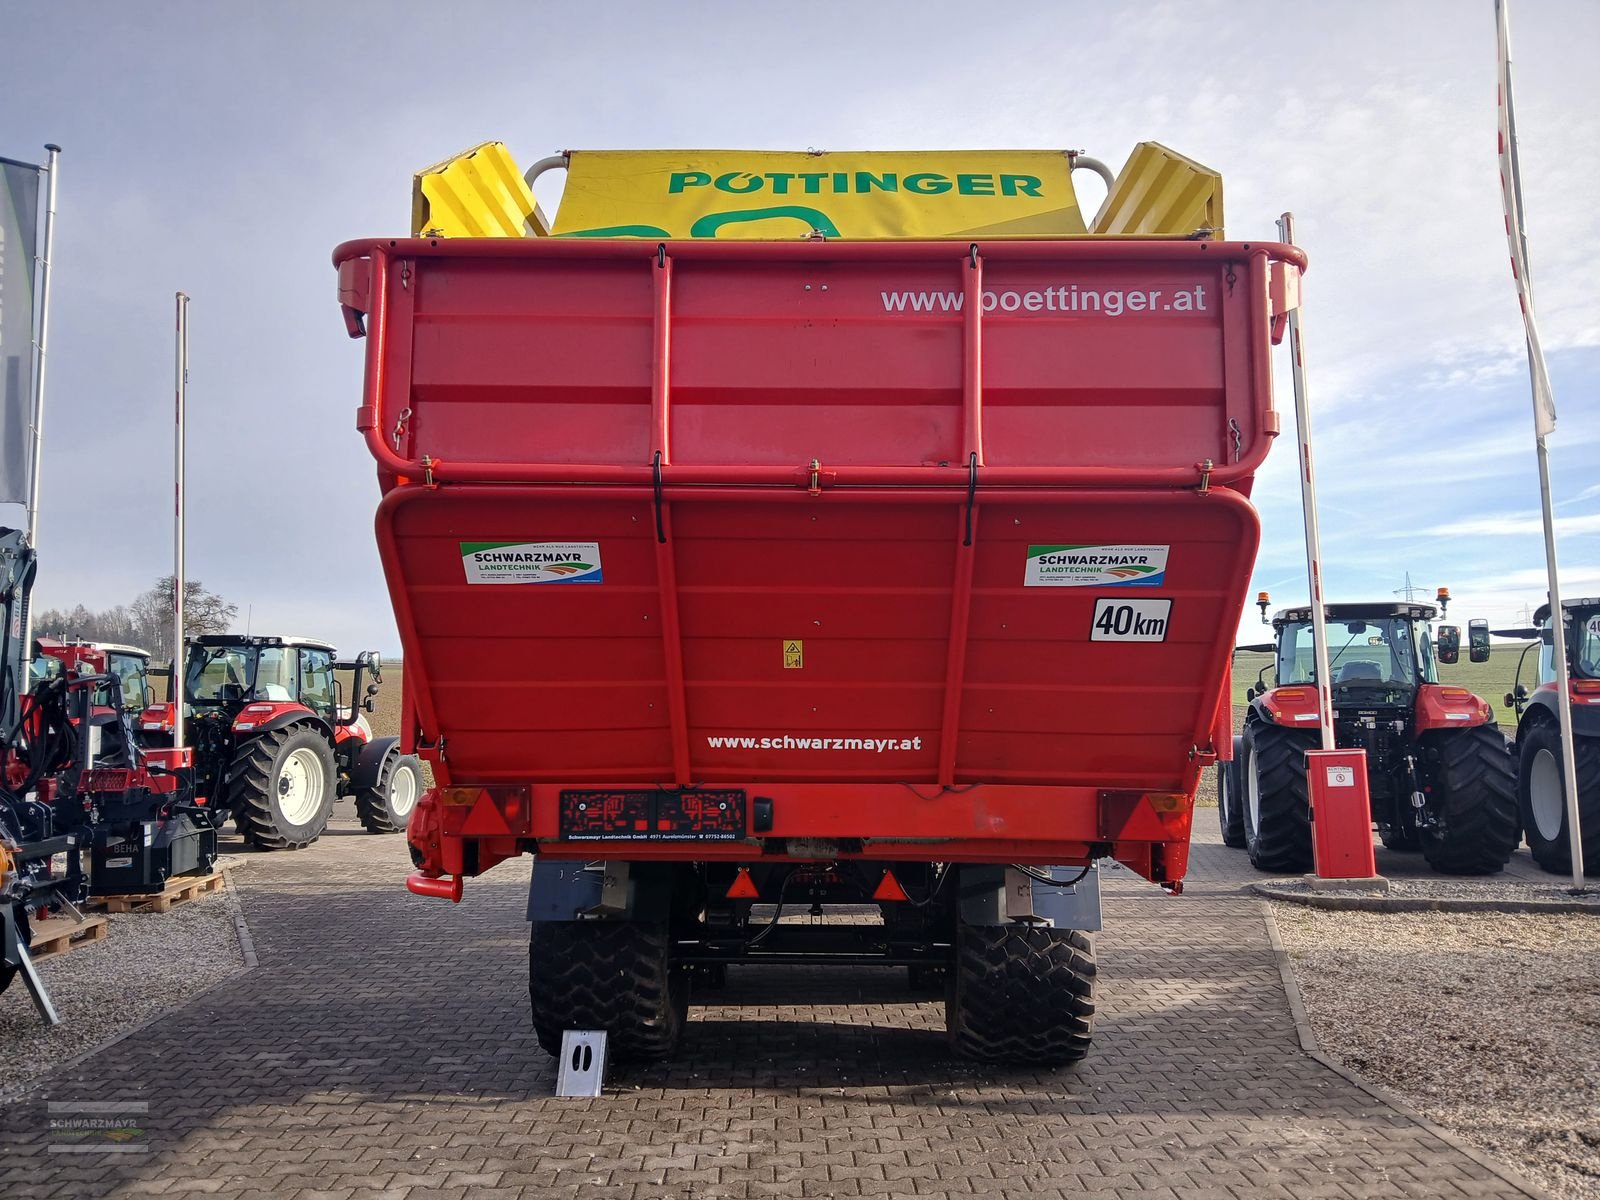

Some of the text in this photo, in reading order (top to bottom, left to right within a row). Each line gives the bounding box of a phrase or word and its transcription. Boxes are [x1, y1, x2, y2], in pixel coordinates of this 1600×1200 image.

[669, 171, 1044, 197] PÖTTINGER
[880, 284, 1207, 316] wwwpoettinger.at
[474, 553, 582, 563] SCHWARZMAYR
[1038, 555, 1148, 565] SCHWARZMAYR
[707, 735, 922, 752] www.schwarzmayr.at
[113, 844, 139, 853] BEHA
